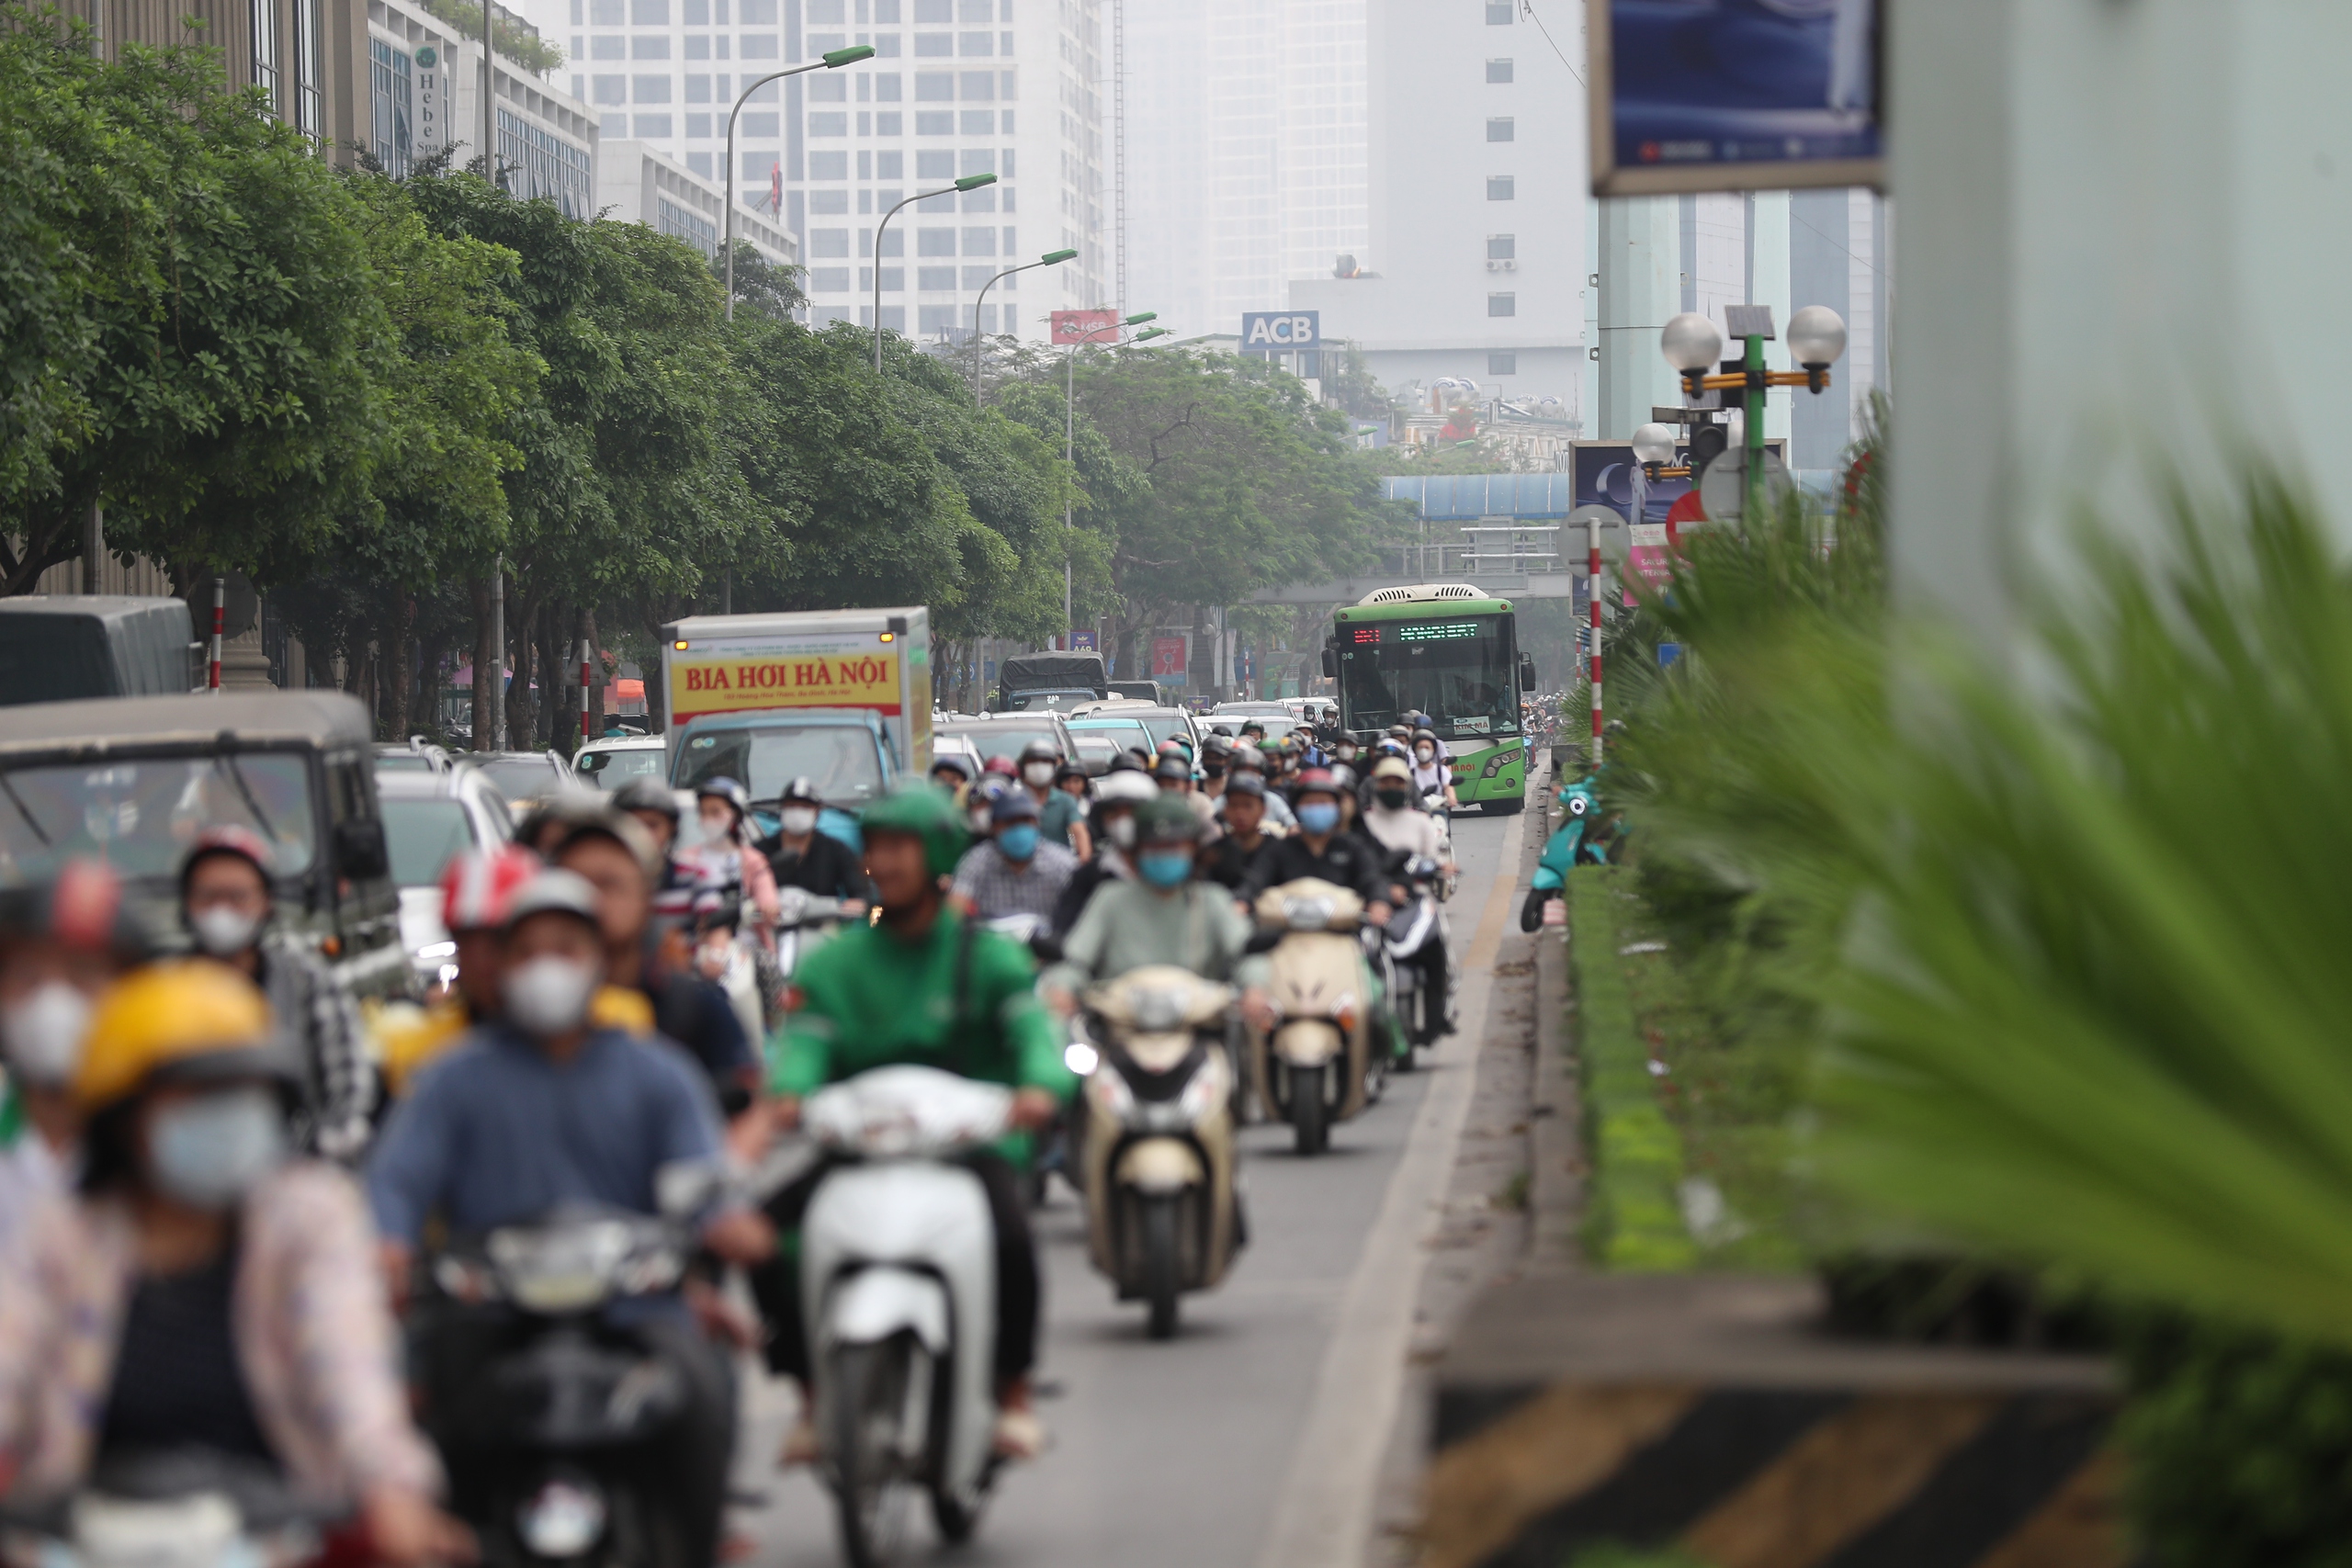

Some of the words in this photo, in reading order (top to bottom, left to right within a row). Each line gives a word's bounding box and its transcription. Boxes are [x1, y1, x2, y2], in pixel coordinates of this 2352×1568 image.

[419, 73, 435, 138] Hebe
[416, 141, 439, 154] Spa
[1248, 316, 1313, 344] ACB
[685, 667, 730, 691] BIA
[737, 664, 786, 689] HƠI
[794, 656, 832, 687] HÀ
[840, 656, 888, 690] NỘI
